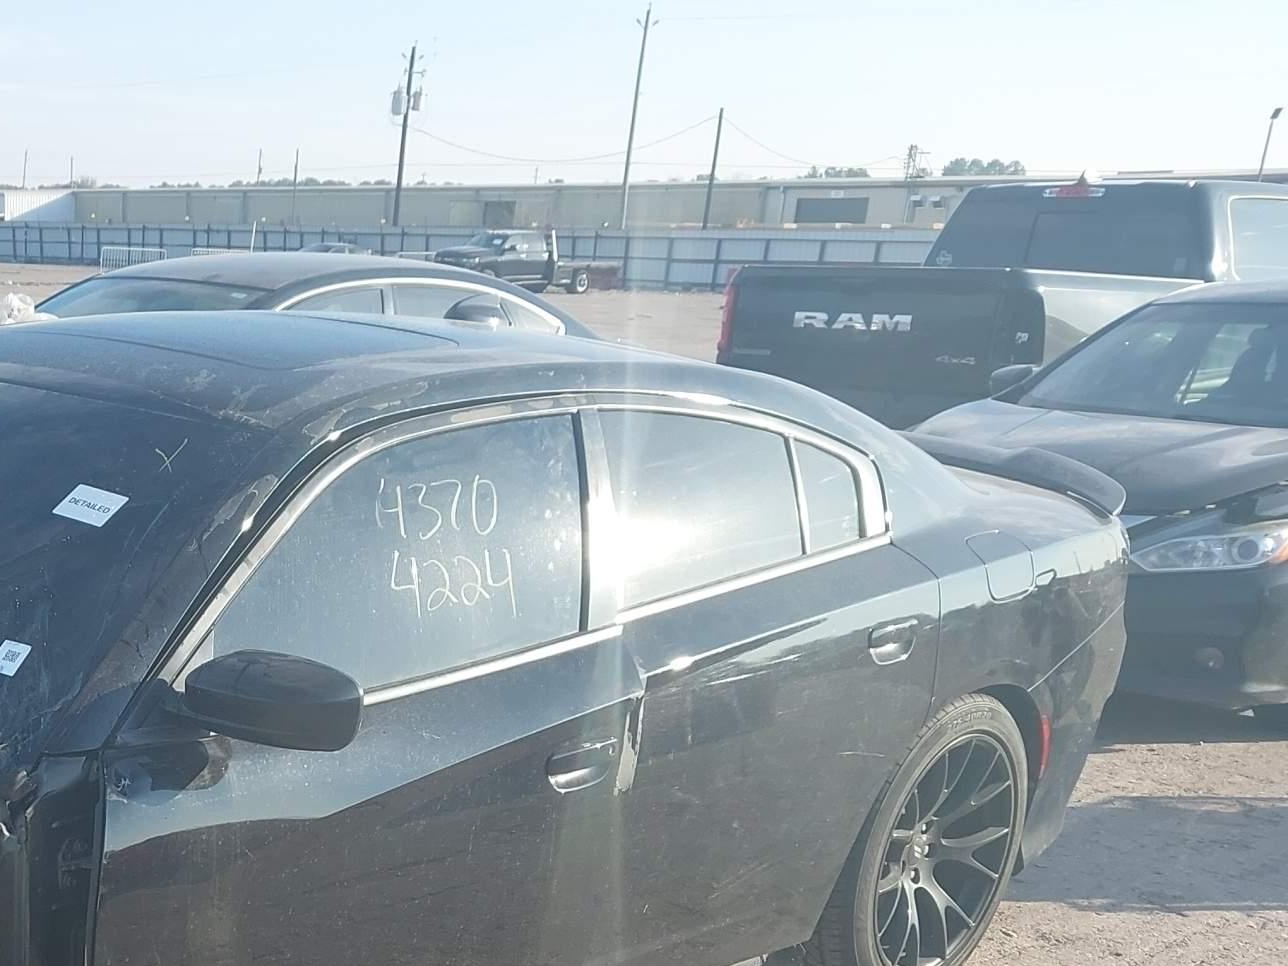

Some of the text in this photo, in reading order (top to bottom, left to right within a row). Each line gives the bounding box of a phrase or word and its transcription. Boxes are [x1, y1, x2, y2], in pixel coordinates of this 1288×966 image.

[793, 311, 912, 331] RAM
[936, 354, 976, 365] 4x4
[68, 496, 111, 514] DETAILED
[375, 474, 497, 540] 4370
[391, 548, 516, 618] 4224
